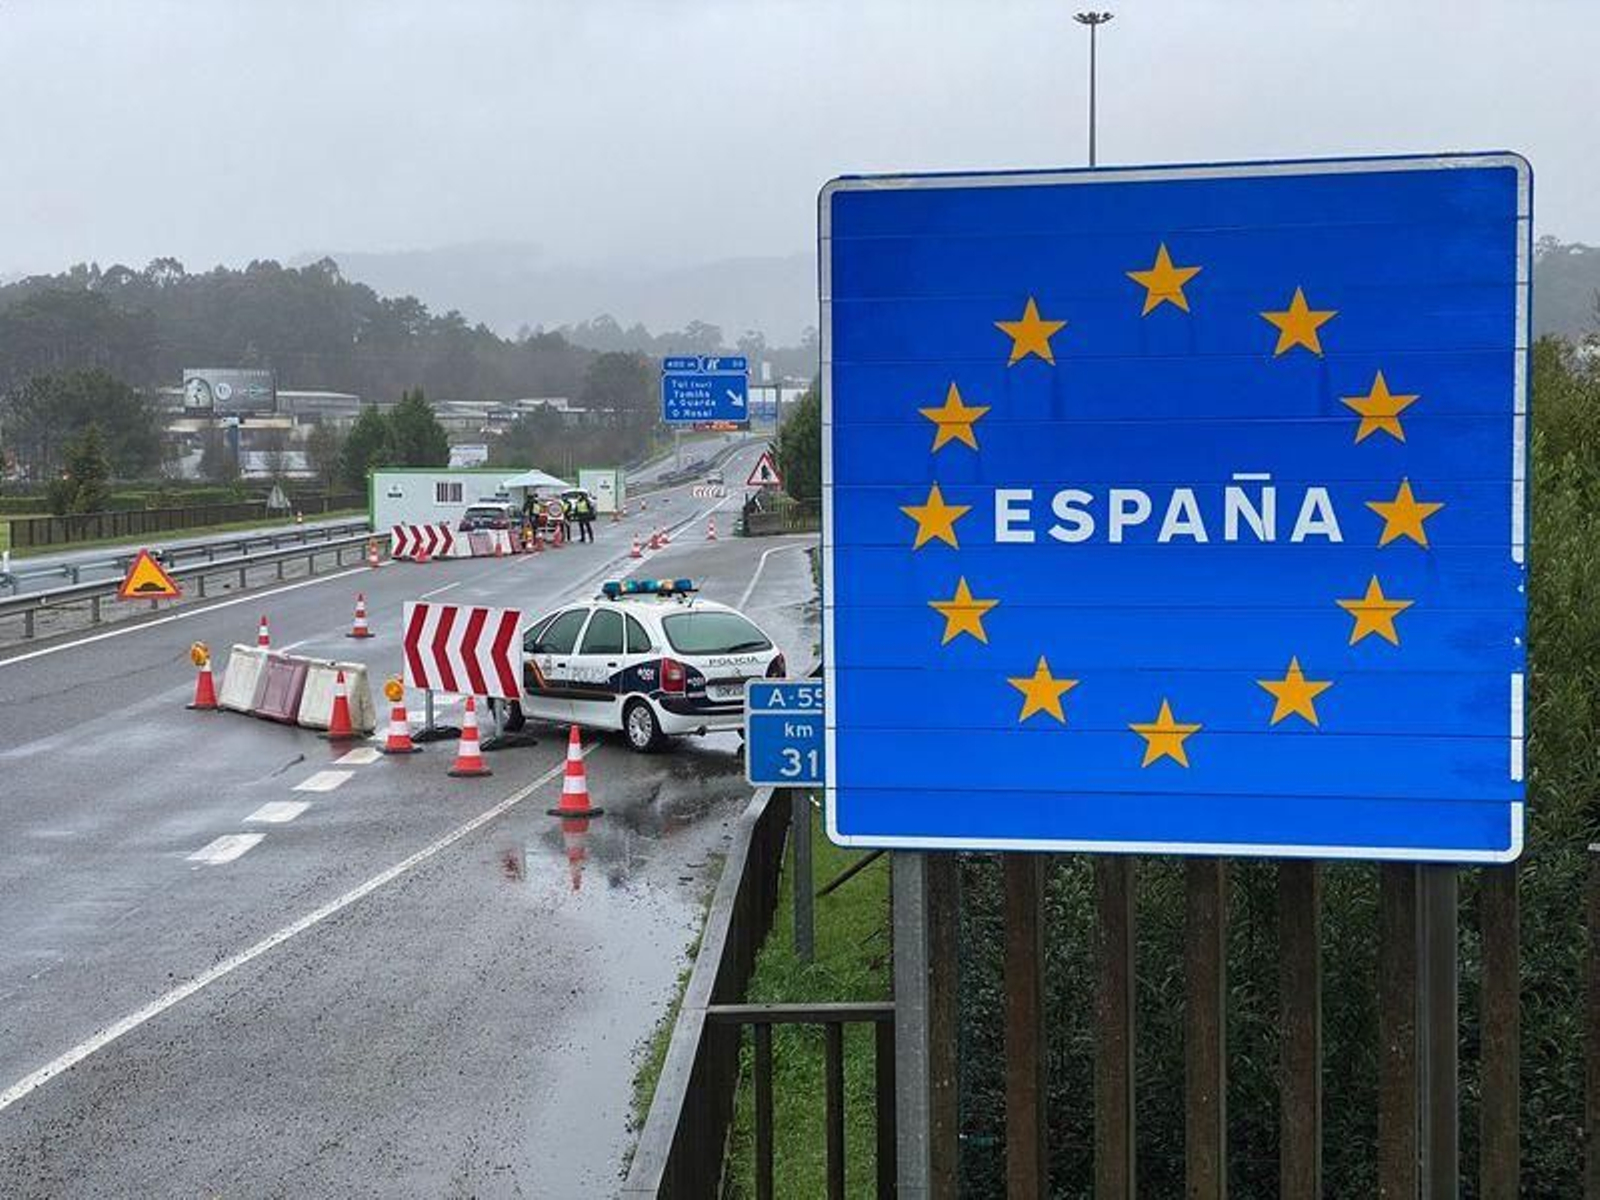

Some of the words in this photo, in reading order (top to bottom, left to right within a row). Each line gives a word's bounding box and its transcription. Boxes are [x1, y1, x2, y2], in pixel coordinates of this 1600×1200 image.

[994, 472, 1344, 543] ESPAÑA
[784, 722, 813, 738] km
[780, 748, 819, 778] 31
